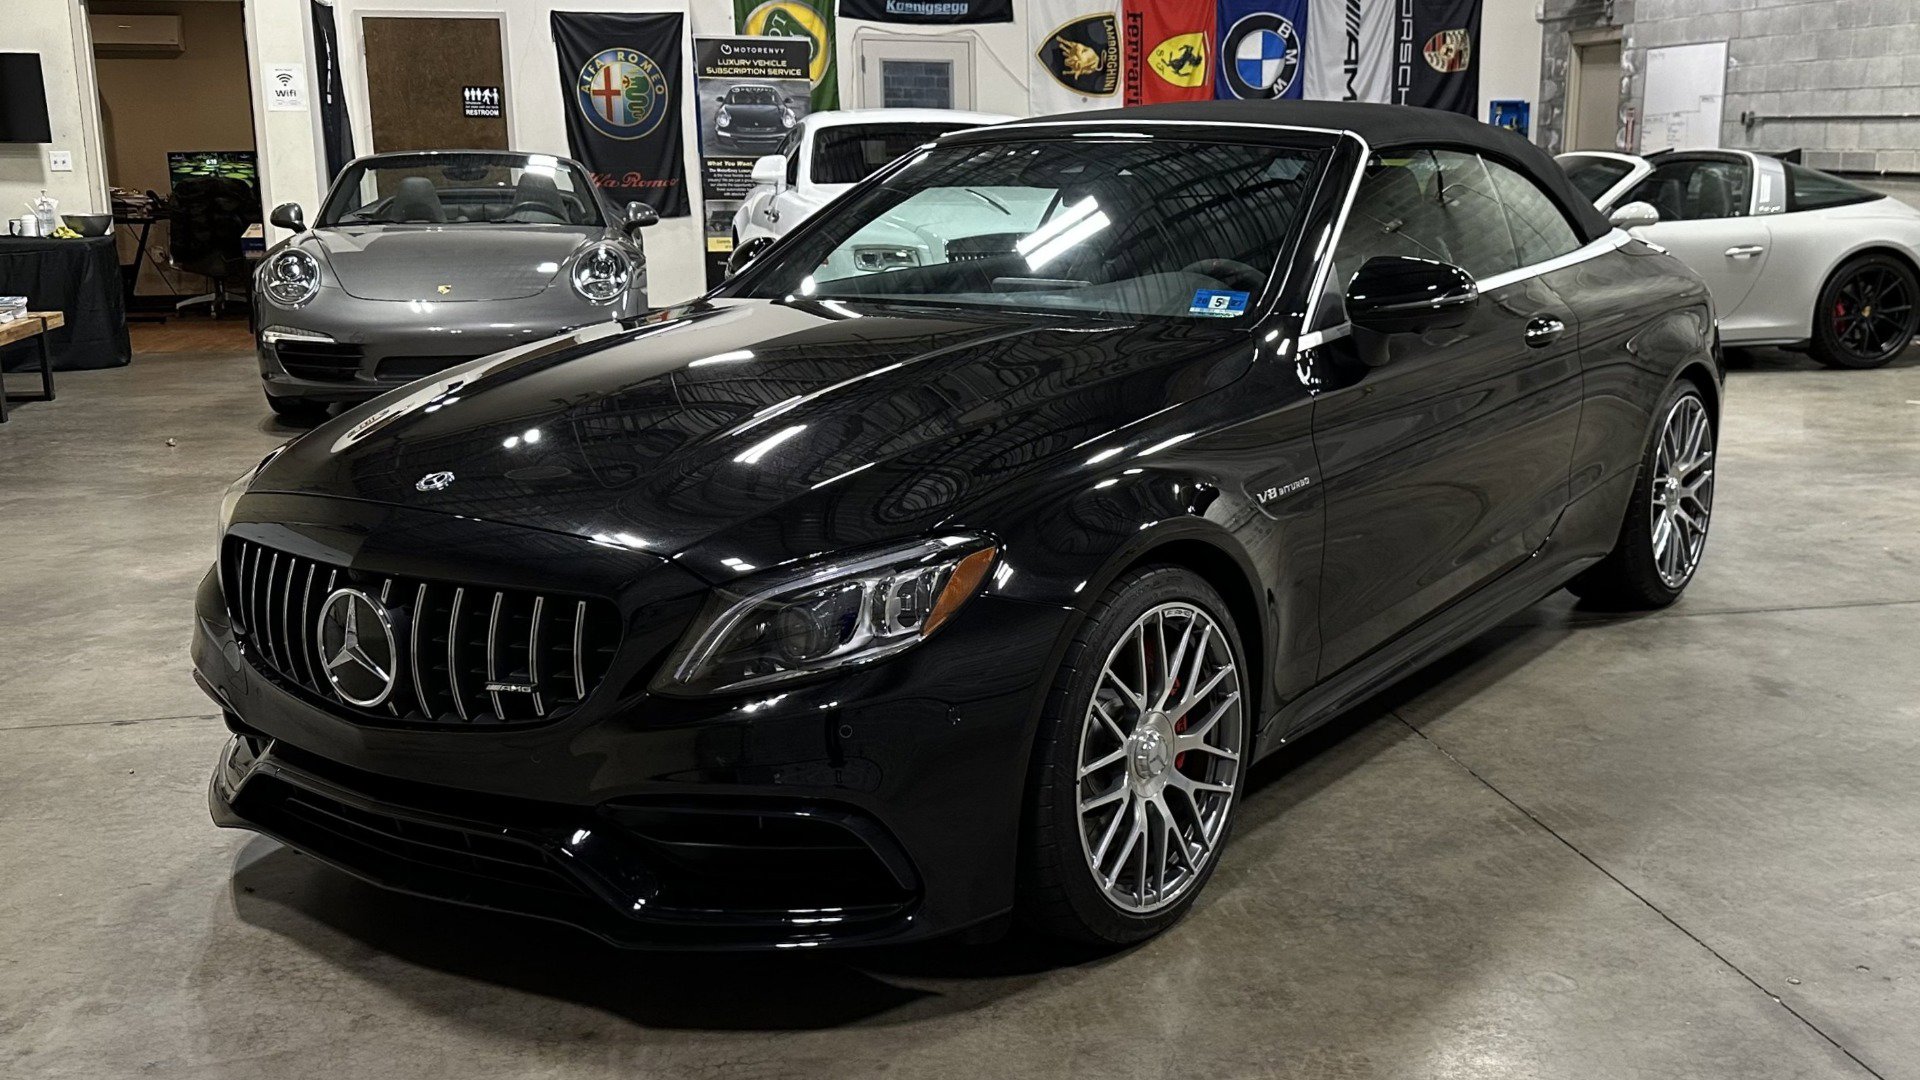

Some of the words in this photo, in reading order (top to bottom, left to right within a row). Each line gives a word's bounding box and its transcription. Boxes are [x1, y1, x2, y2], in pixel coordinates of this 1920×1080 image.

[886, 0, 968, 15] Koenigsegg
[1102, 18, 1118, 91] LAMBORGHINI
[1126, 11, 1143, 107] Ferrari
[1272, 22, 1298, 95] BMW
[1342, 37, 1360, 102] AM
[1398, 0, 1412, 106] ORSCH
[581, 58, 604, 94] ALFA
[617, 51, 665, 94] ROMEO
[706, 67, 766, 75] SUBSCRIPTION
[767, 68, 802, 76] SERVICE
[275, 89, 297, 97] Wifi
[1214, 297, 1224, 307] 5
[1256, 487, 1278, 504] V8
[1279, 477, 1310, 496] BITURBO
[500, 685, 531, 693] AMG
